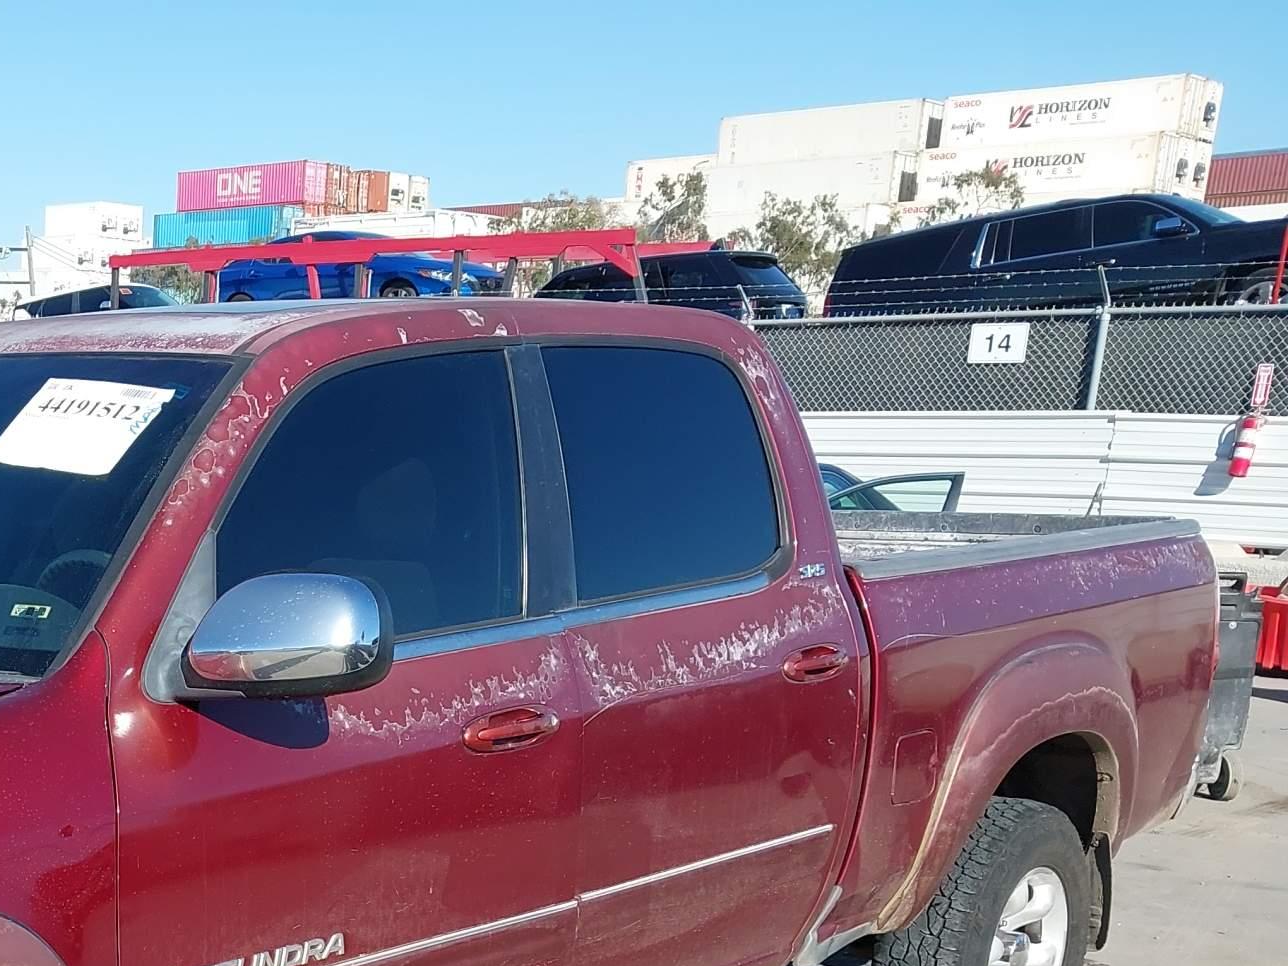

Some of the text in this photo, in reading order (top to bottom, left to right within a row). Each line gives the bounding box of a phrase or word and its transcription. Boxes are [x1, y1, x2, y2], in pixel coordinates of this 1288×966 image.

[953, 99, 982, 109] seaco
[1037, 97, 1111, 115] HORIZON
[1035, 112, 1098, 125] LINES
[929, 152, 957, 161] seaco
[1013, 152, 1086, 169] HORIZON
[217, 170, 262, 196] ONE
[985, 333, 1012, 353] 14
[38, 397, 142, 421] 44191512
